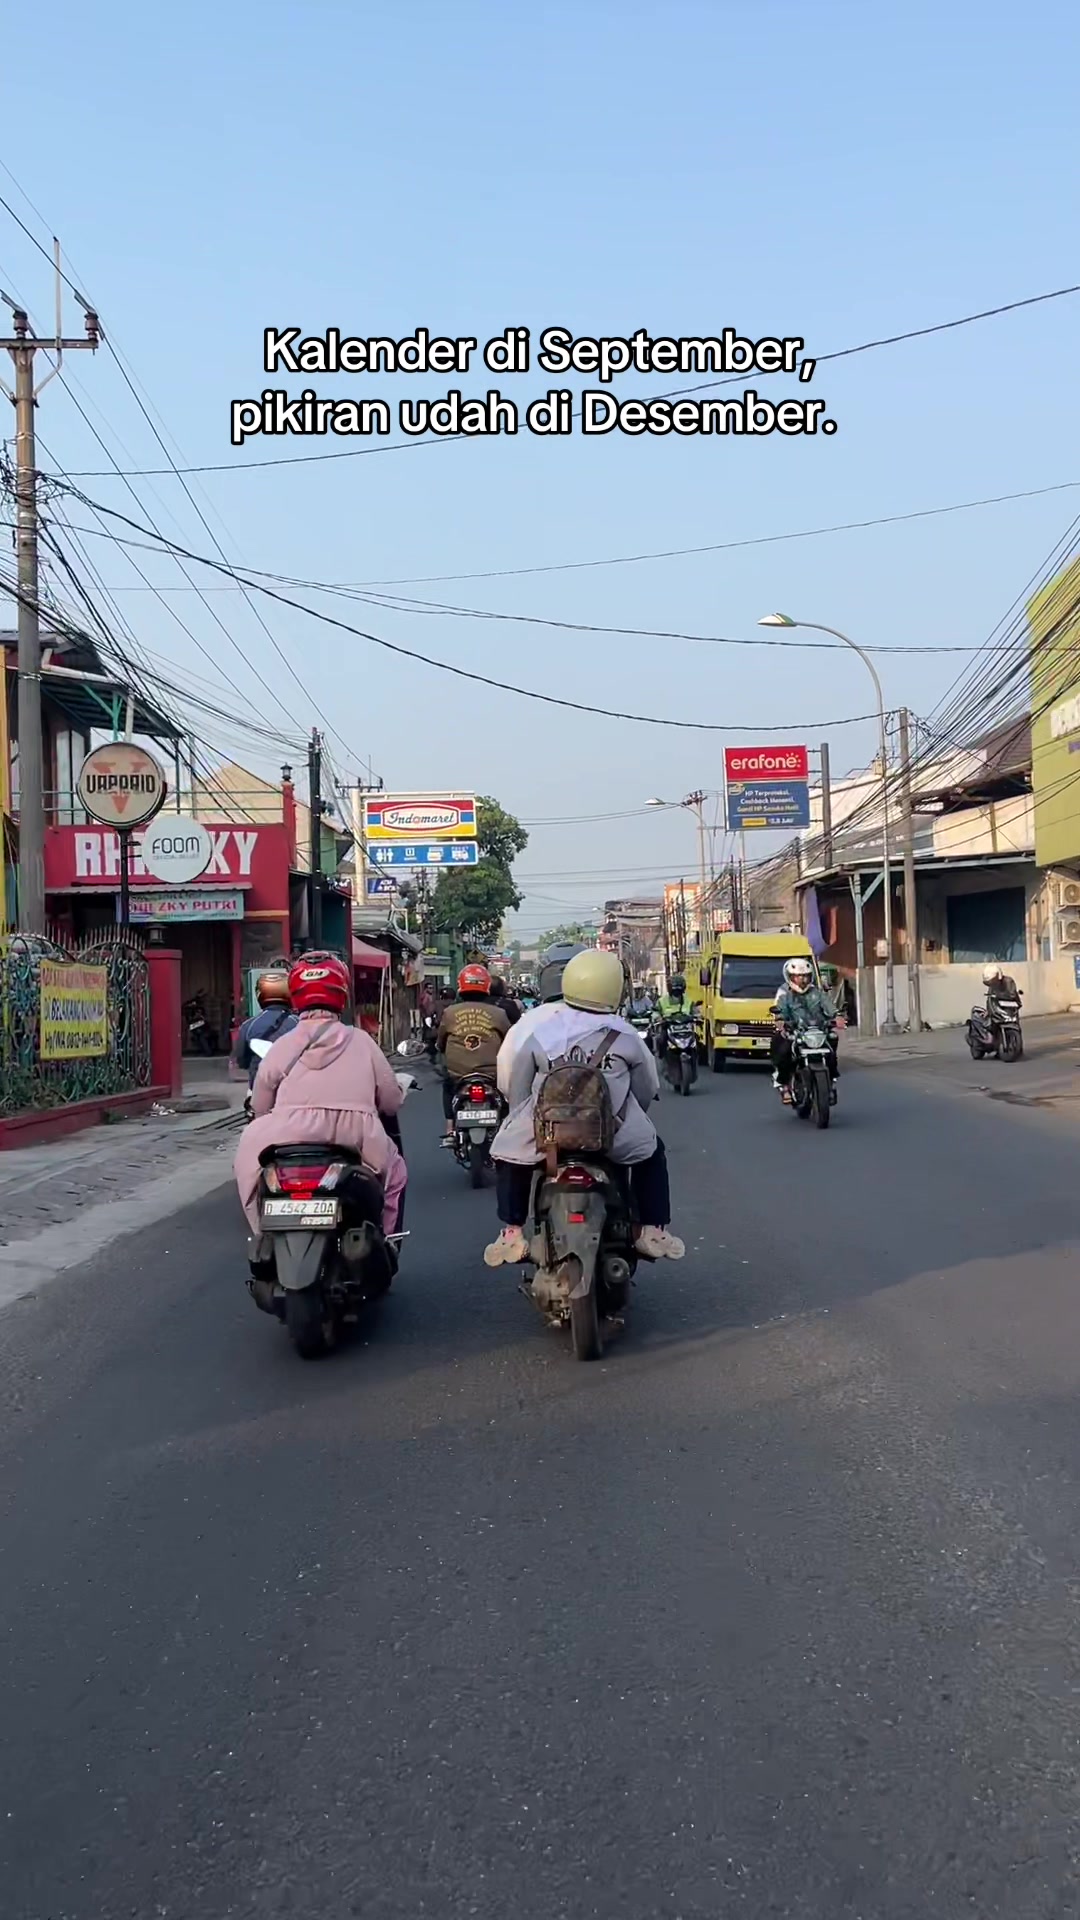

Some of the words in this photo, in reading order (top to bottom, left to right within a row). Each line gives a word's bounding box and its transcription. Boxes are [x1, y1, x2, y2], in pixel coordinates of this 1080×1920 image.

[730, 754, 797, 770] erafone
[388, 812, 455, 825] Indomaret
[152, 836, 200, 854] FOOM
[266, 1203, 273, 1214] D
